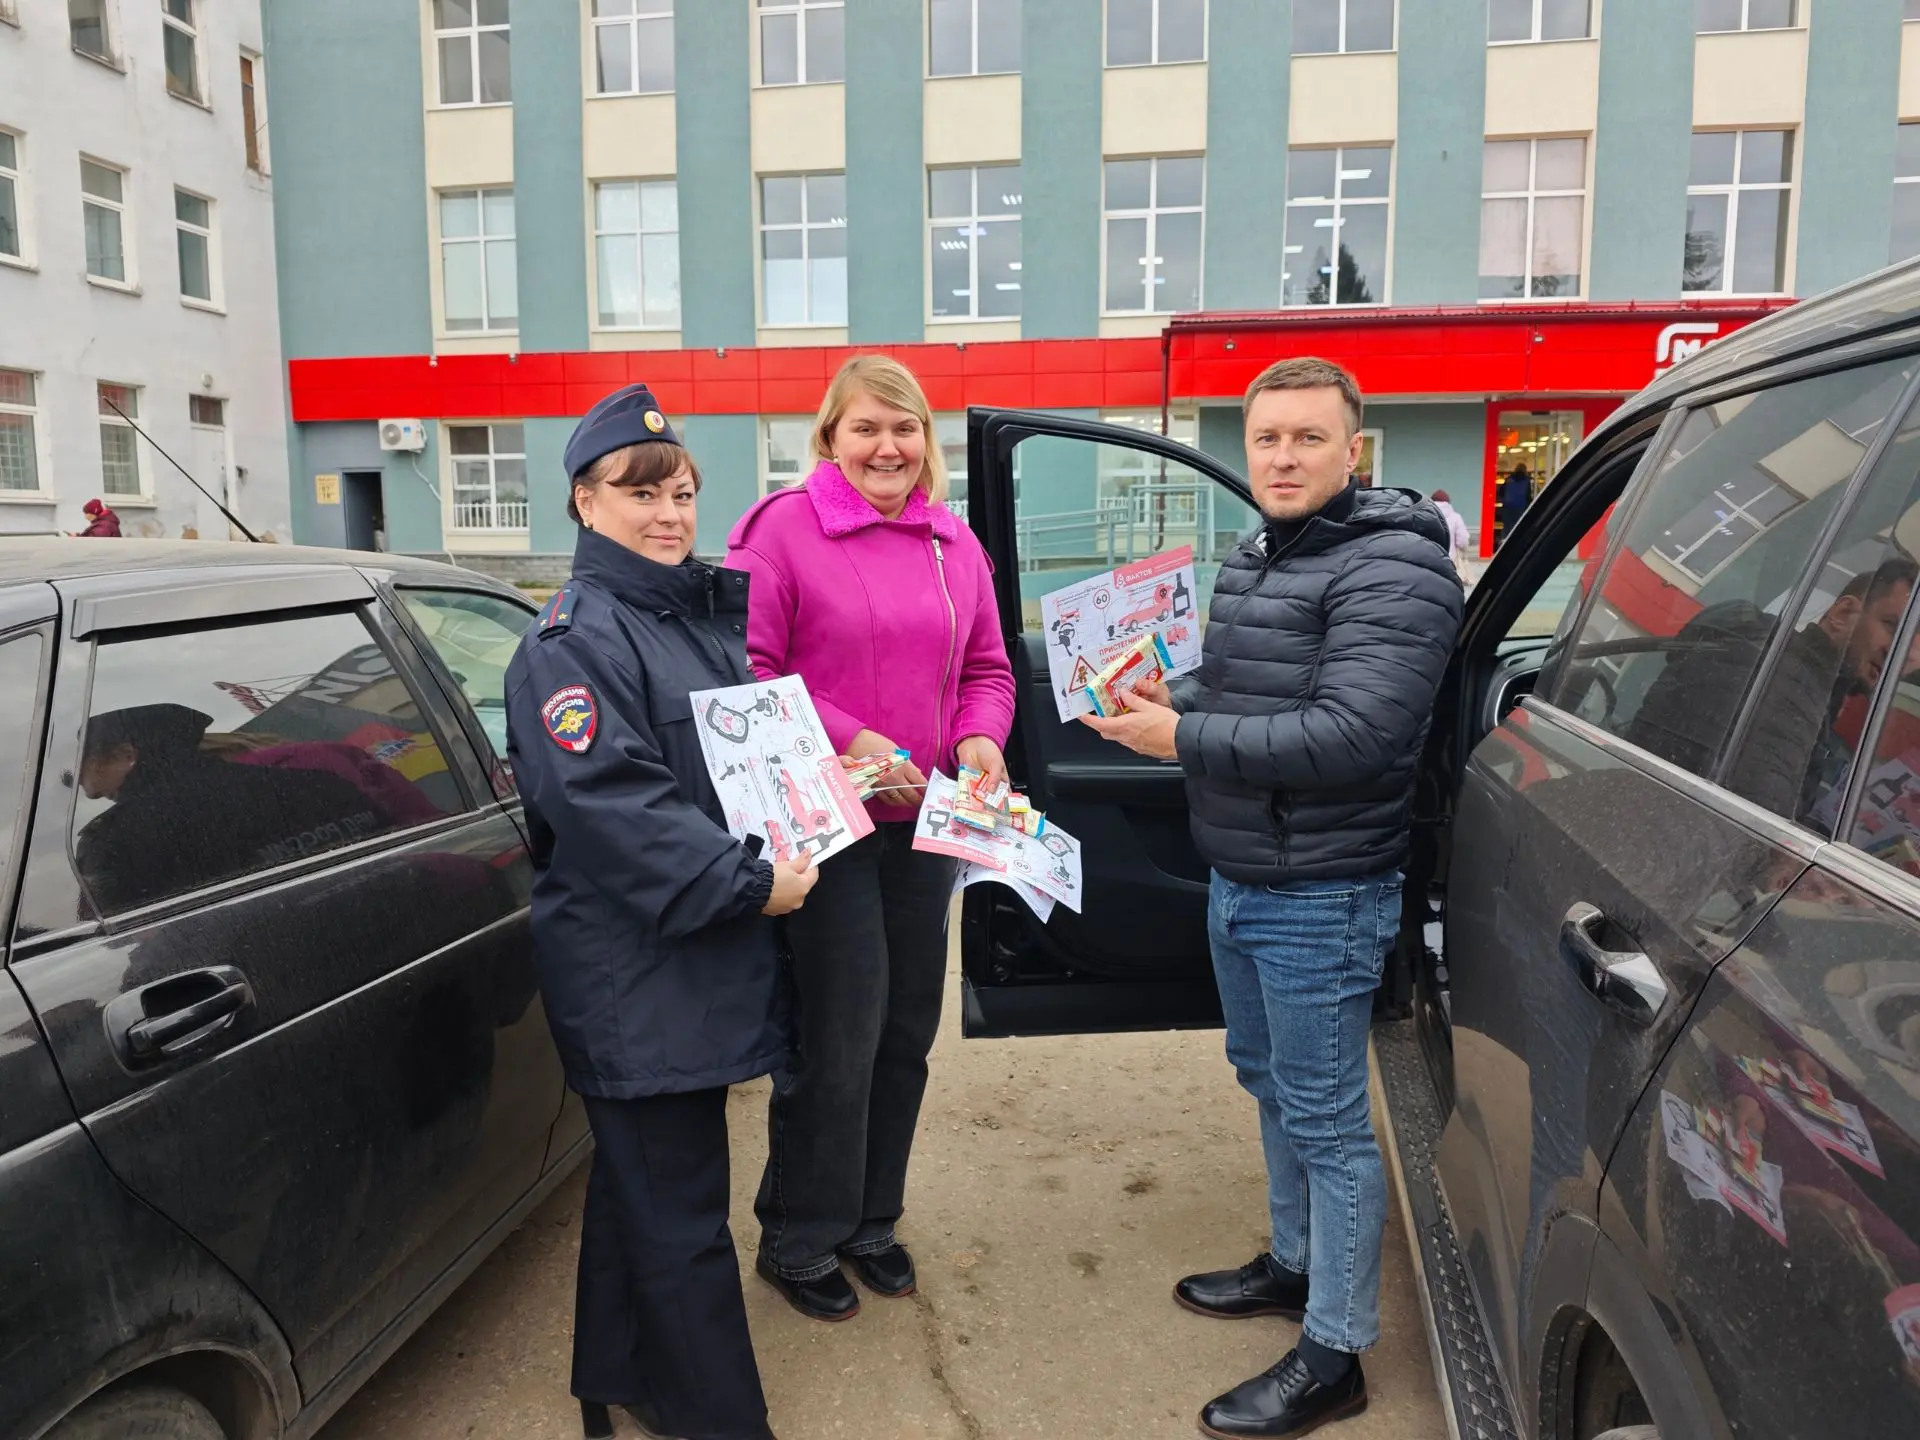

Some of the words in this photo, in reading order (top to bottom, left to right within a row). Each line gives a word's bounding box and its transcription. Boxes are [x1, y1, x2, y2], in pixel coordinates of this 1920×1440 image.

[1096, 594, 1108, 605] 60
[1098, 633, 1145, 657] ПРИСТЕГНИТЕ
[544, 688, 587, 716] ПОЛИЦИЯ
[551, 698, 585, 722] РОССИЯ
[571, 735, 590, 751] МВД
[798, 740, 811, 754] 60
